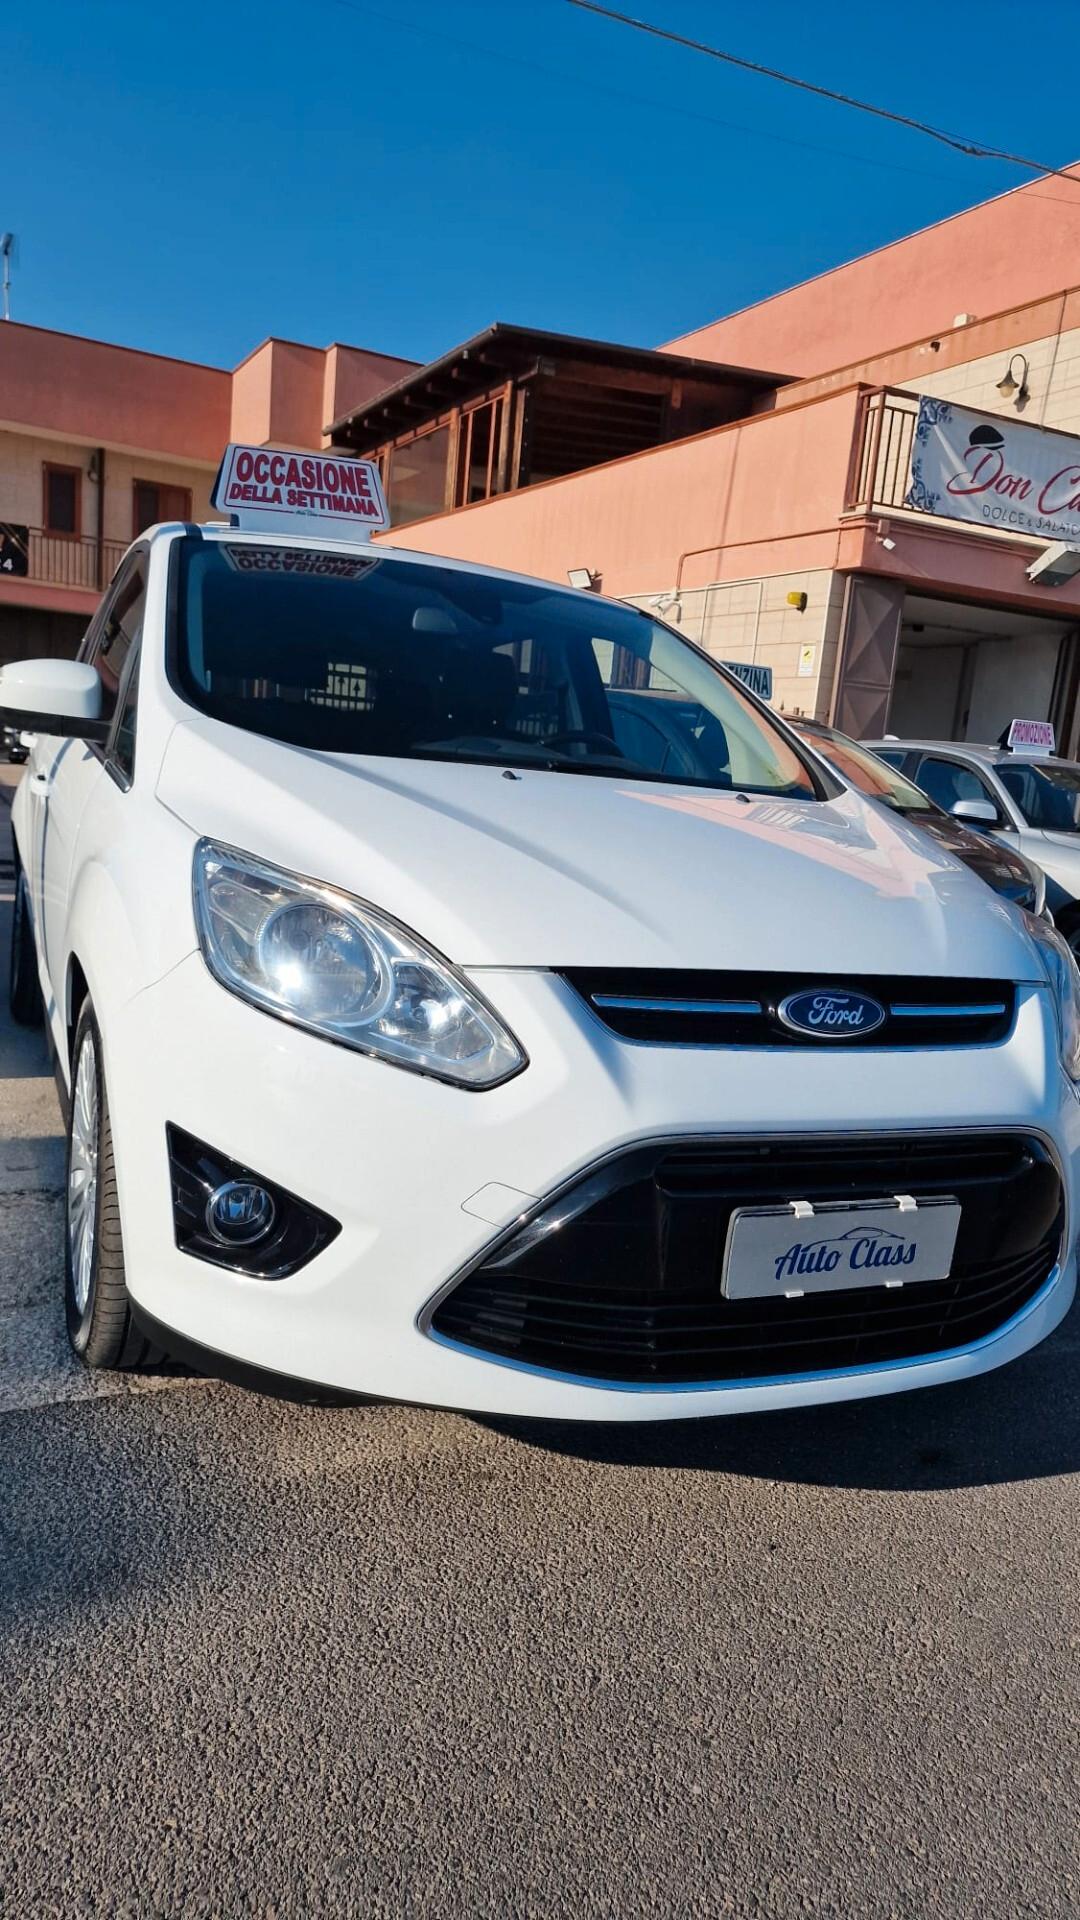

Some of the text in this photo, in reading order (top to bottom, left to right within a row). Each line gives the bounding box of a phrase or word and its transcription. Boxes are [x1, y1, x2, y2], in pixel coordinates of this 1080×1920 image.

[236, 452, 372, 497] OCCASIONE
[947, 446, 1033, 499] Don
[229, 483, 379, 517] DELLA SETTIMANA
[983, 504, 1025, 525] DOLCE
[0, 558, 13, 571] 4
[1013, 723, 1052, 746] PROMOZIONE
[808, 997, 864, 1025] Ford
[775, 1239, 917, 1280] Auto Class
